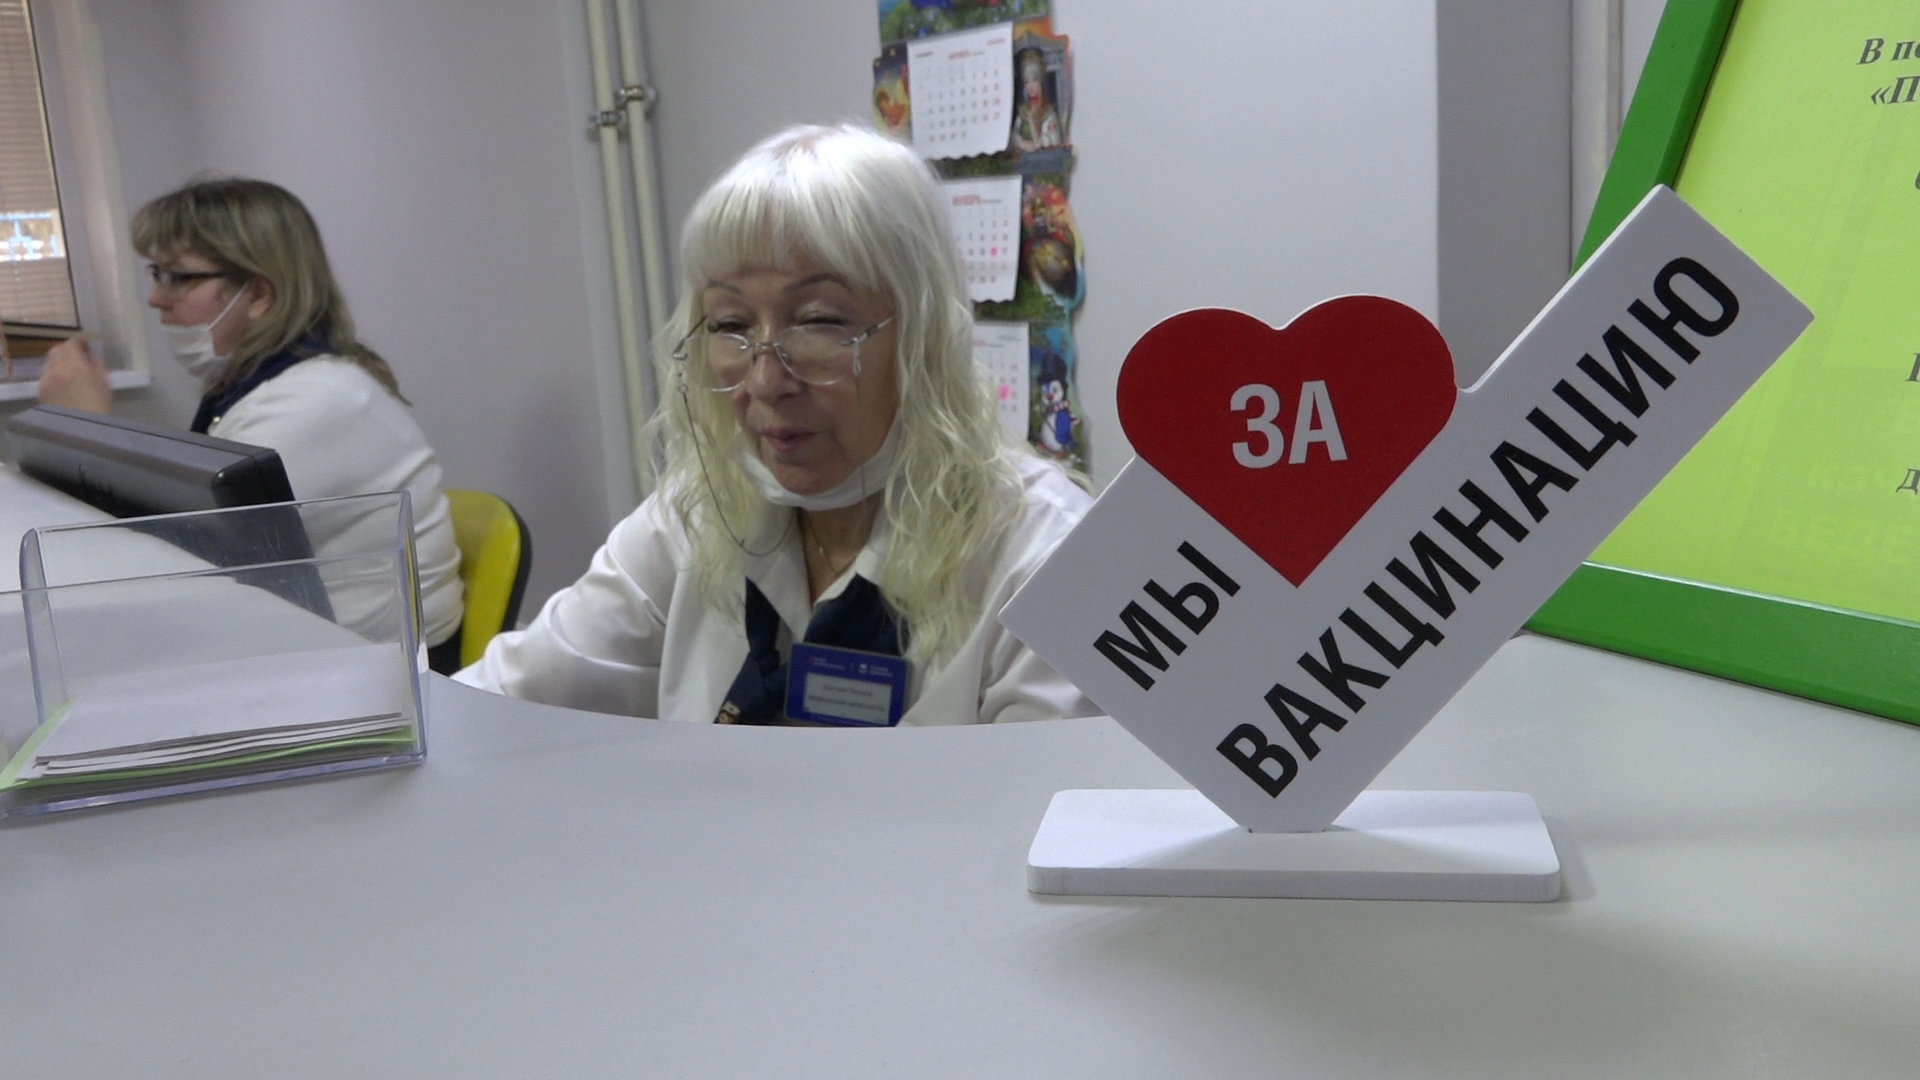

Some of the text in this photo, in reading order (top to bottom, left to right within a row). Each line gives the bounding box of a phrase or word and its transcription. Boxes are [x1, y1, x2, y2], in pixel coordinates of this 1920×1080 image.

[1856, 38, 1885, 65] В
[1230, 380, 1348, 469] ЗА
[1216, 256, 1740, 799] ВАКЦИНАЦИЮ
[1094, 541, 1242, 691] МЫ
